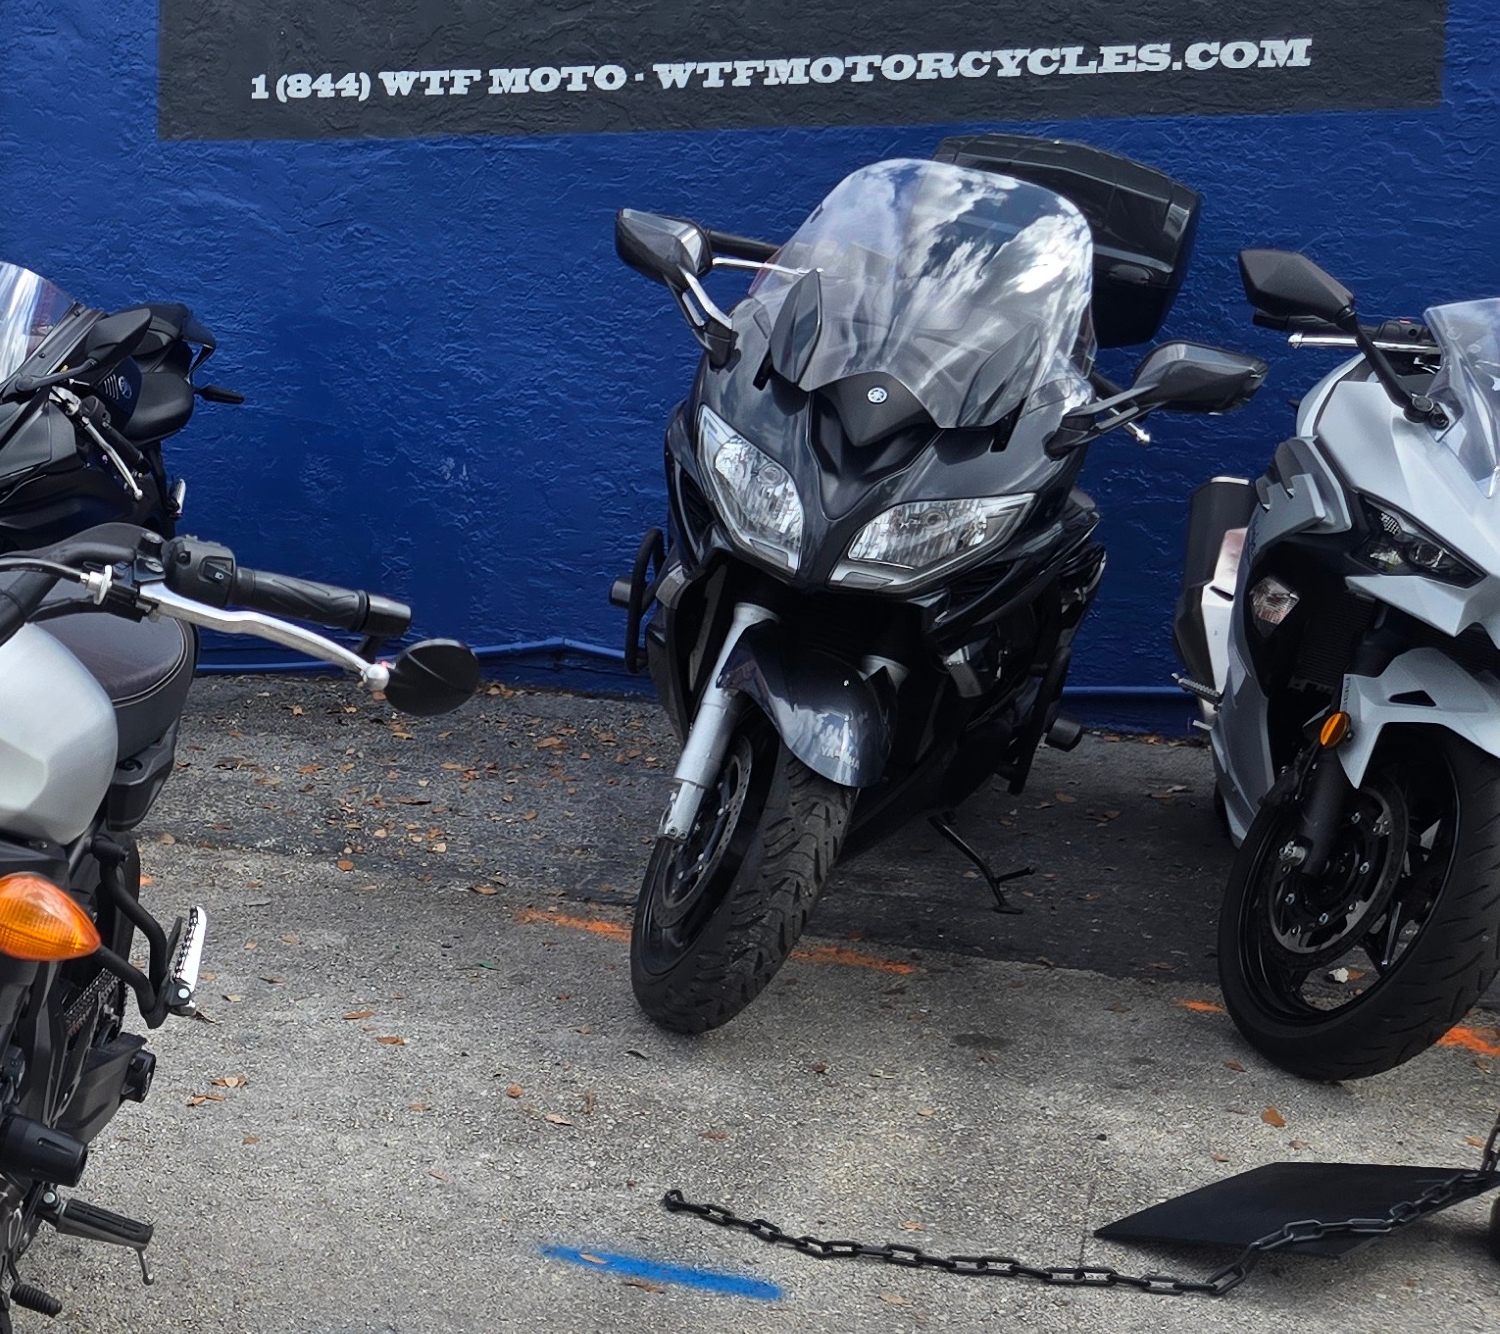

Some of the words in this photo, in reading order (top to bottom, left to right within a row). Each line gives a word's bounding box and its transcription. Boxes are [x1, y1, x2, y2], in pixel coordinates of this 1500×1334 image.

[378, 69, 481, 97] WTF
[488, 64, 627, 94] MOTO
[652, 38, 1312, 89] WTFMOTORCYCLES.COM
[821, 746, 860, 770] YAHA
